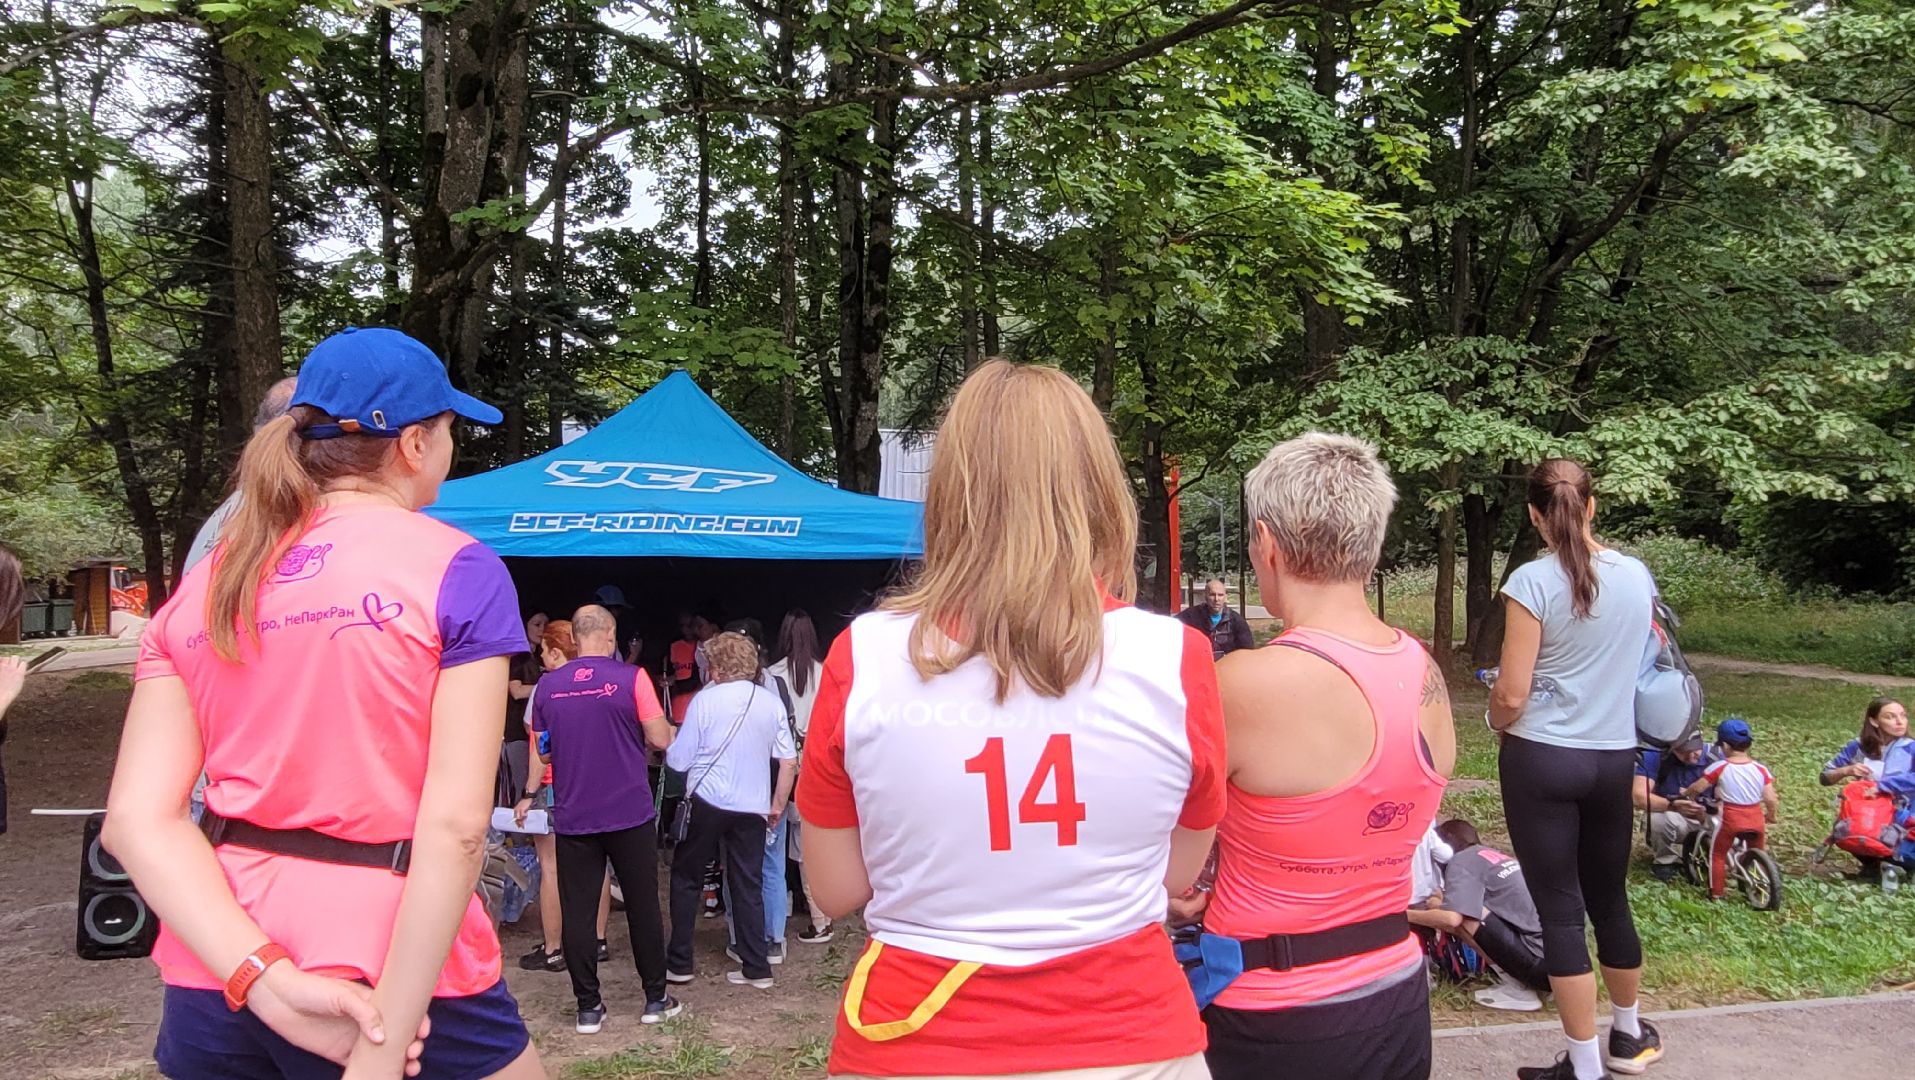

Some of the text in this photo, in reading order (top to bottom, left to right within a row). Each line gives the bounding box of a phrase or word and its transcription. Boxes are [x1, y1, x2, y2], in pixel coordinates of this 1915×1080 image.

[544, 460, 777, 492] YCF
[509, 512, 801, 537] YCF-RIDING.COM
[284, 606, 355, 628] НеПаркРан
[964, 733, 1087, 852] 14
